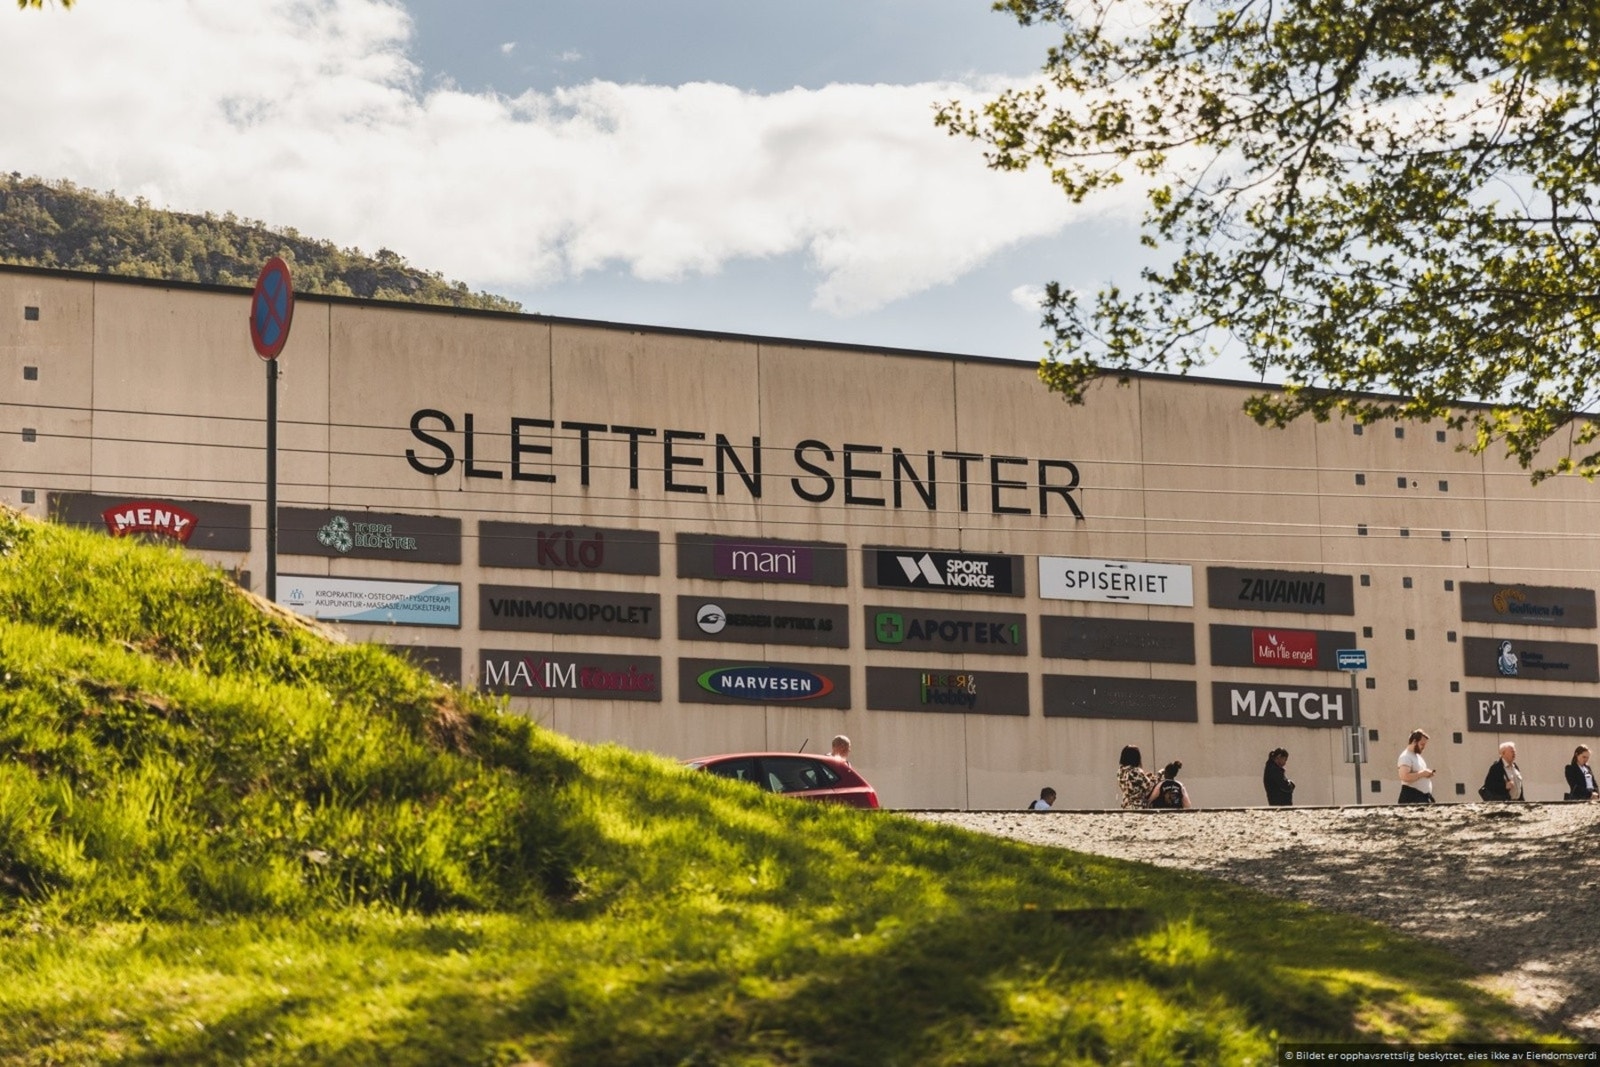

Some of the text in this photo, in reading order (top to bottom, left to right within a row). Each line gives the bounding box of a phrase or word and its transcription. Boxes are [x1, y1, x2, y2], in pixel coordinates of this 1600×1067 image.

[405, 409, 1086, 520] SLETTEN SENTER
[114, 508, 189, 532] MENY
[354, 533, 418, 551] BLOMSTER
[537, 530, 604, 569] Kid
[732, 549, 796, 574] mani
[946, 559, 989, 575] SPORT
[946, 574, 995, 589] NORGE
[1064, 569, 1169, 593] SPISERIET
[1238, 577, 1326, 605] ZAVANNA
[315, 590, 451, 603] KIROPRAKTIKK OSTEOPATI FYSIOTERAPI
[315, 599, 362, 608] AKUPUNKTUR
[488, 597, 652, 625] VINMONOPOLET
[817, 619, 833, 632] AS
[906, 619, 1020, 645] APOTEK 1
[1259, 645, 1276, 659] Min
[1291, 647, 1313, 664] engel
[485, 655, 577, 693] MAXIM
[721, 674, 812, 692] NARVESEN
[926, 688, 976, 710] Hobby
[1231, 688, 1344, 721] MATCH
[1508, 709, 1594, 730] HÅRSTUDIO
